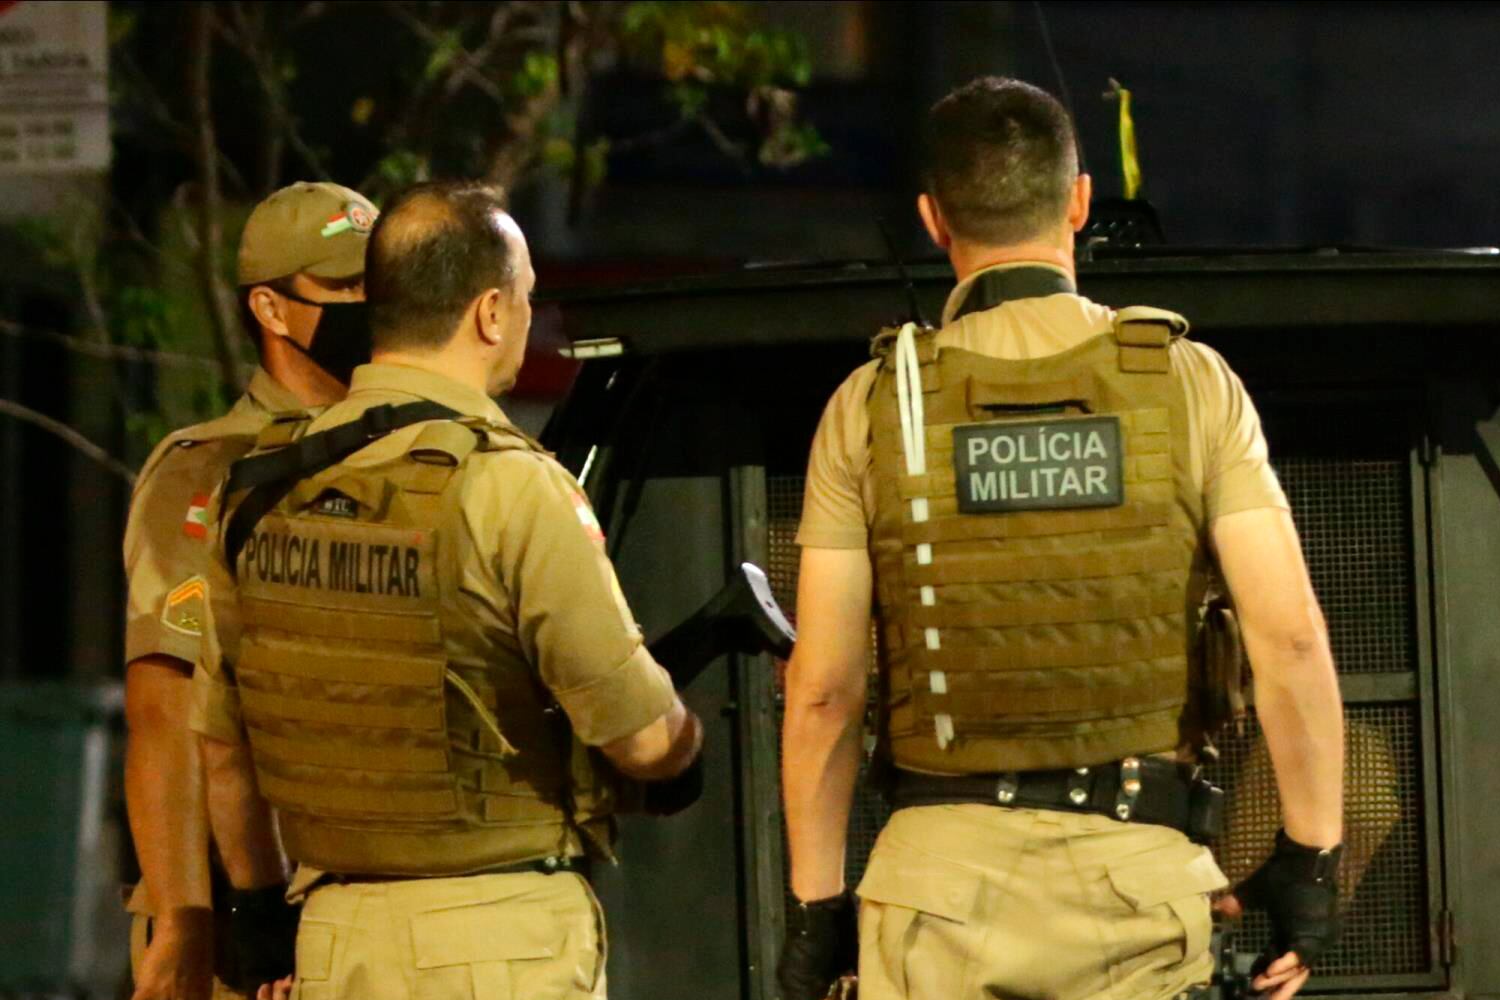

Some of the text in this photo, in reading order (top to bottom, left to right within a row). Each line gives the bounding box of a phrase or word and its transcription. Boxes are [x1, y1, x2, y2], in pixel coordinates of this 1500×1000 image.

[967, 427, 1108, 466] POLÍCIA
[969, 465, 1109, 501] MILITAR
[329, 541, 420, 598] MILITAR
